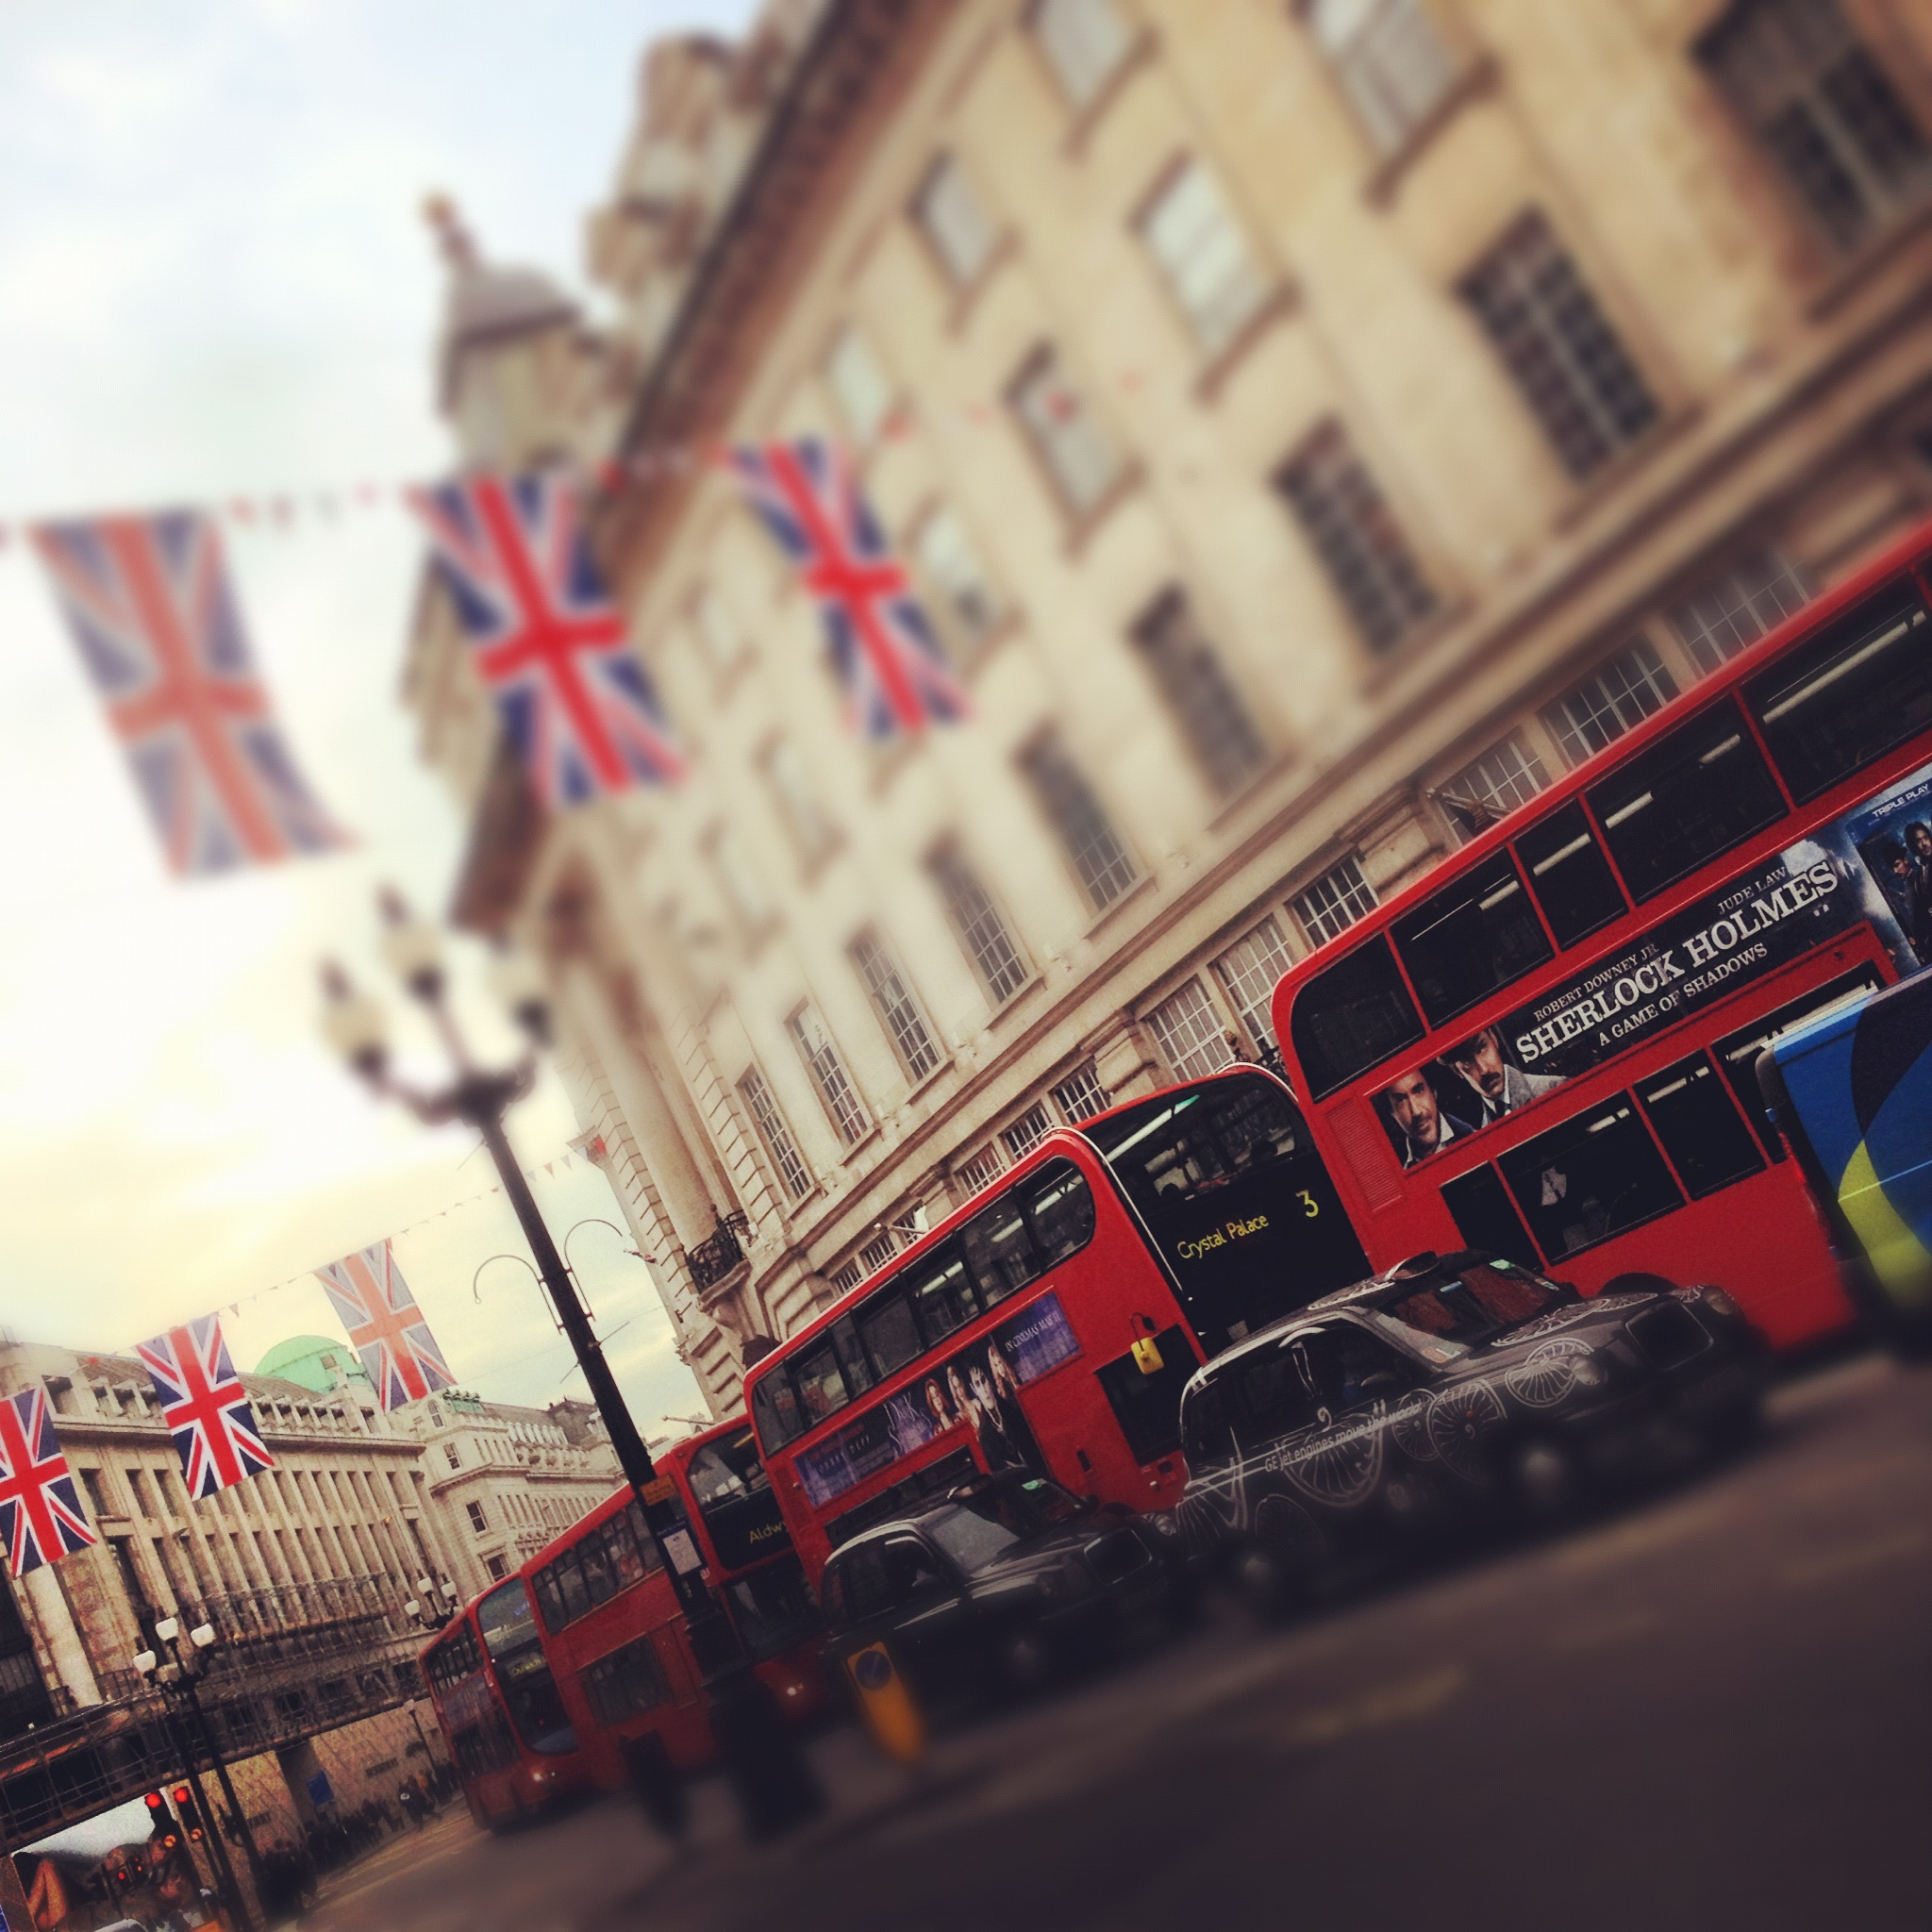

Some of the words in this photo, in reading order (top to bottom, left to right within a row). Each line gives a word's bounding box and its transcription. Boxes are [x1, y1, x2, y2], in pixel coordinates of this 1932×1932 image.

[1873, 797, 1905, 817] TRIPLE
[1906, 784, 1929, 801] PLAY
[1718, 887, 1755, 914] JUDE
[1755, 866, 1787, 891] LAW
[1516, 949, 1685, 1063] SHERLOCK
[1682, 860, 1838, 968] HOLMES
[1534, 987, 1582, 1022] ROBERT
[1584, 954, 1638, 992] DOWNEY
[1641, 943, 1659, 961] JR
[1598, 1032, 1610, 1046] A
[1611, 1004, 1658, 1039] GAME
[1658, 990, 1681, 1011] OF
[1683, 942, 1768, 997] SHADOWS
[1295, 1189, 1319, 1217] 3
[1177, 1227, 1227, 1259] Crystal
[1225, 1215, 1269, 1240] Palace
[1005, 1340, 1013, 1352] IN
[1012, 1324, 1040, 1347] CINEMAS
[1265, 1455, 1279, 1472] GE
[1278, 1451, 1292, 1471] jet
[1294, 1435, 1334, 1460] engines
[1336, 1424, 1366, 1445] move
[1367, 1415, 1387, 1431] the
